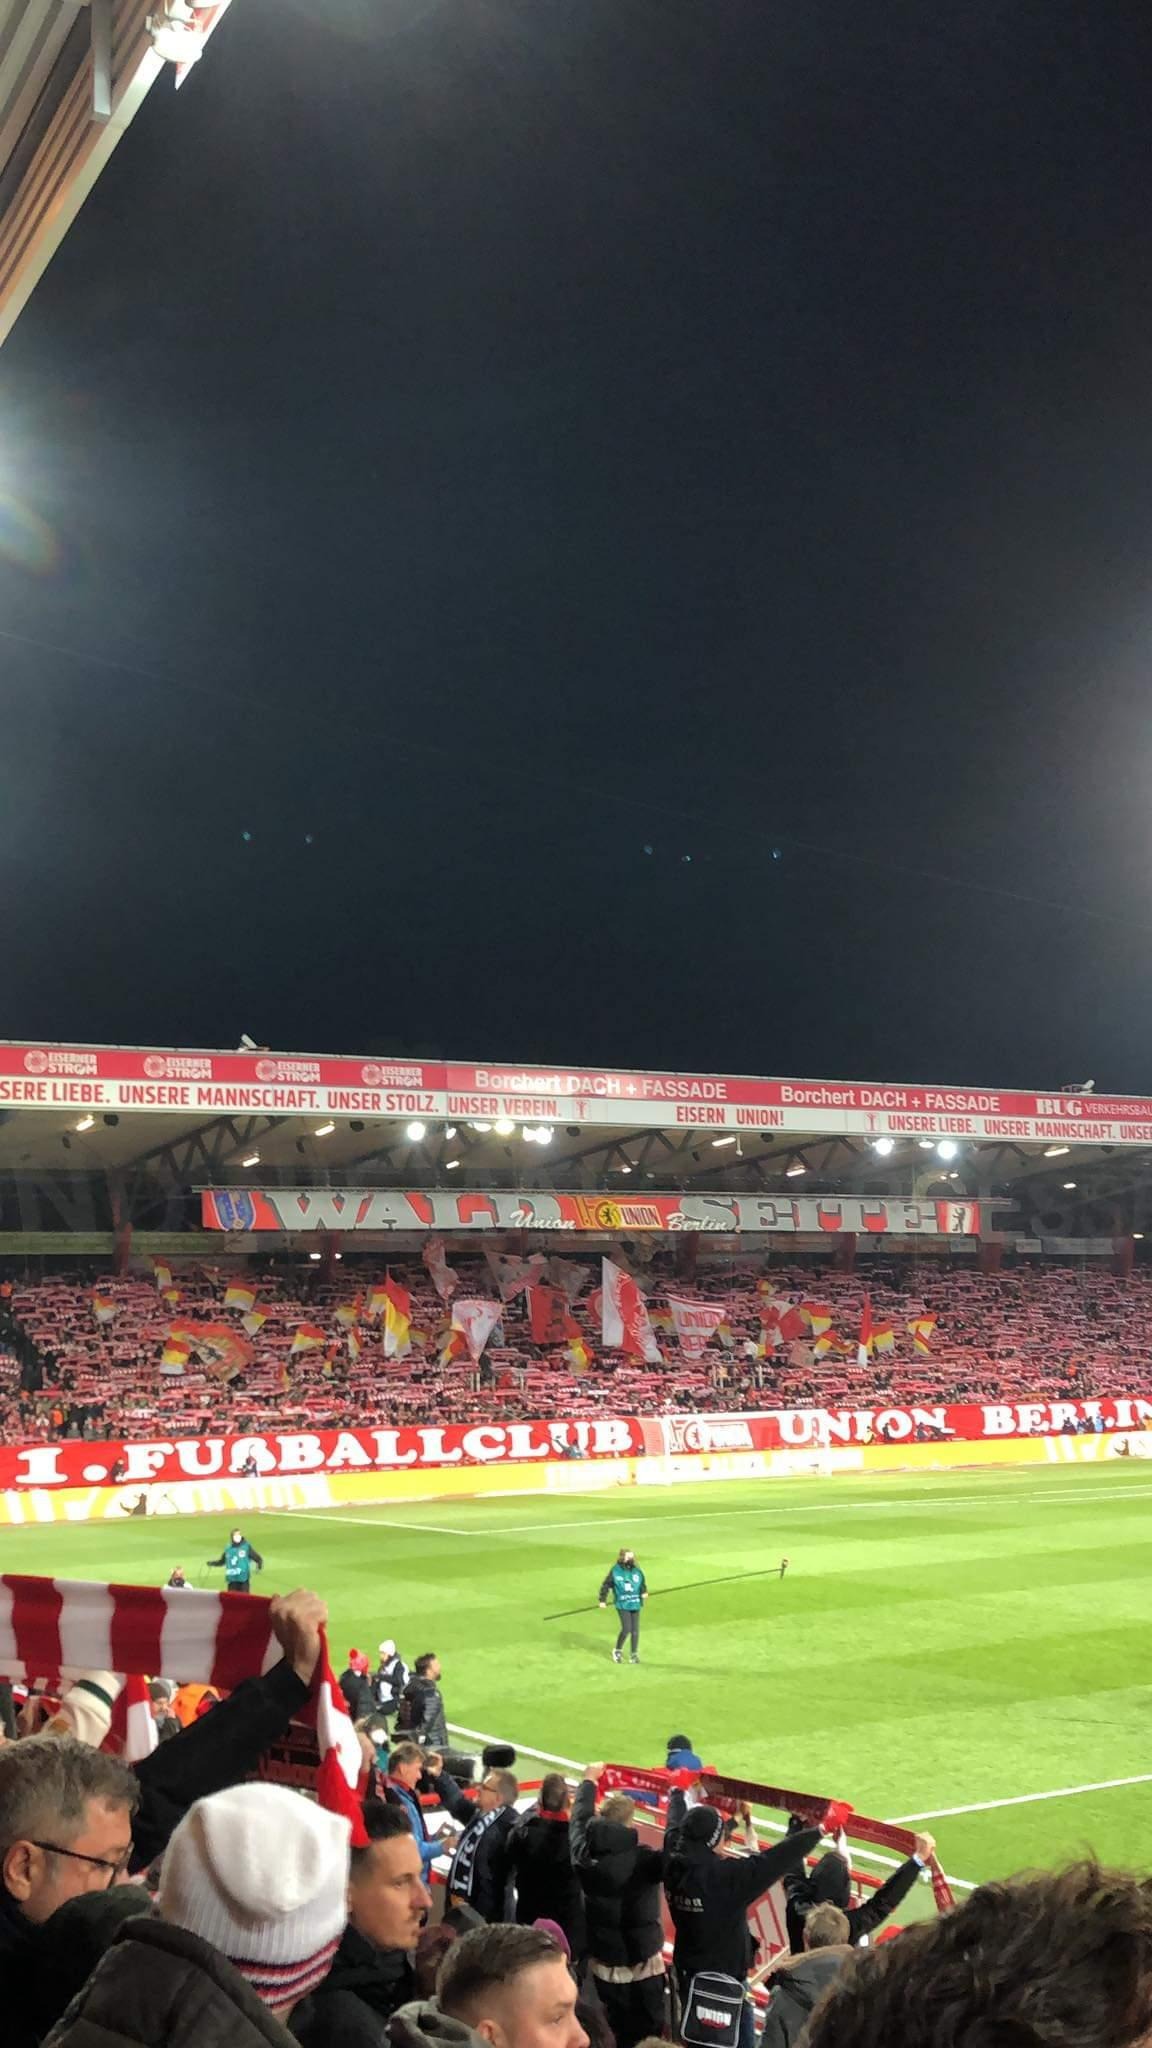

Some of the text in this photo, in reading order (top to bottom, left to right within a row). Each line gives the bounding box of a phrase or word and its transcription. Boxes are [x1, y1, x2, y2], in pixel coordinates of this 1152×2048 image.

[475, 1070, 561, 1092] Borchert
[567, 1075, 620, 1095] DACH
[643, 1079, 727, 1099] FASSADE
[52, 1083, 110, 1104] LIEBE.
[119, 1085, 190, 1105] UNSERE
[198, 1087, 320, 1109] MANNSCHAFT.
[327, 1091, 381, 1111] UNSER
[386, 1093, 439, 1112] STOLZ.
[449, 1096, 498, 1115] UNSER
[502, 1098, 561, 1118] VEREIN.
[781, 1085, 855, 1105] Borchert
[860, 1090, 906, 1108] DACH
[925, 1093, 1000, 1112] FASSADE
[676, 1106, 785, 1126] EISERN UNION!
[888, 1114, 1152, 1140] UNSERE LIEBE. UNSERE MANNSCHAFT. UNSE
[510, 1209, 576, 1229] Union
[620, 1207, 661, 1226] UNION
[666, 1212, 729, 1231] Berlin
[775, 1406, 955, 1445] UNION
